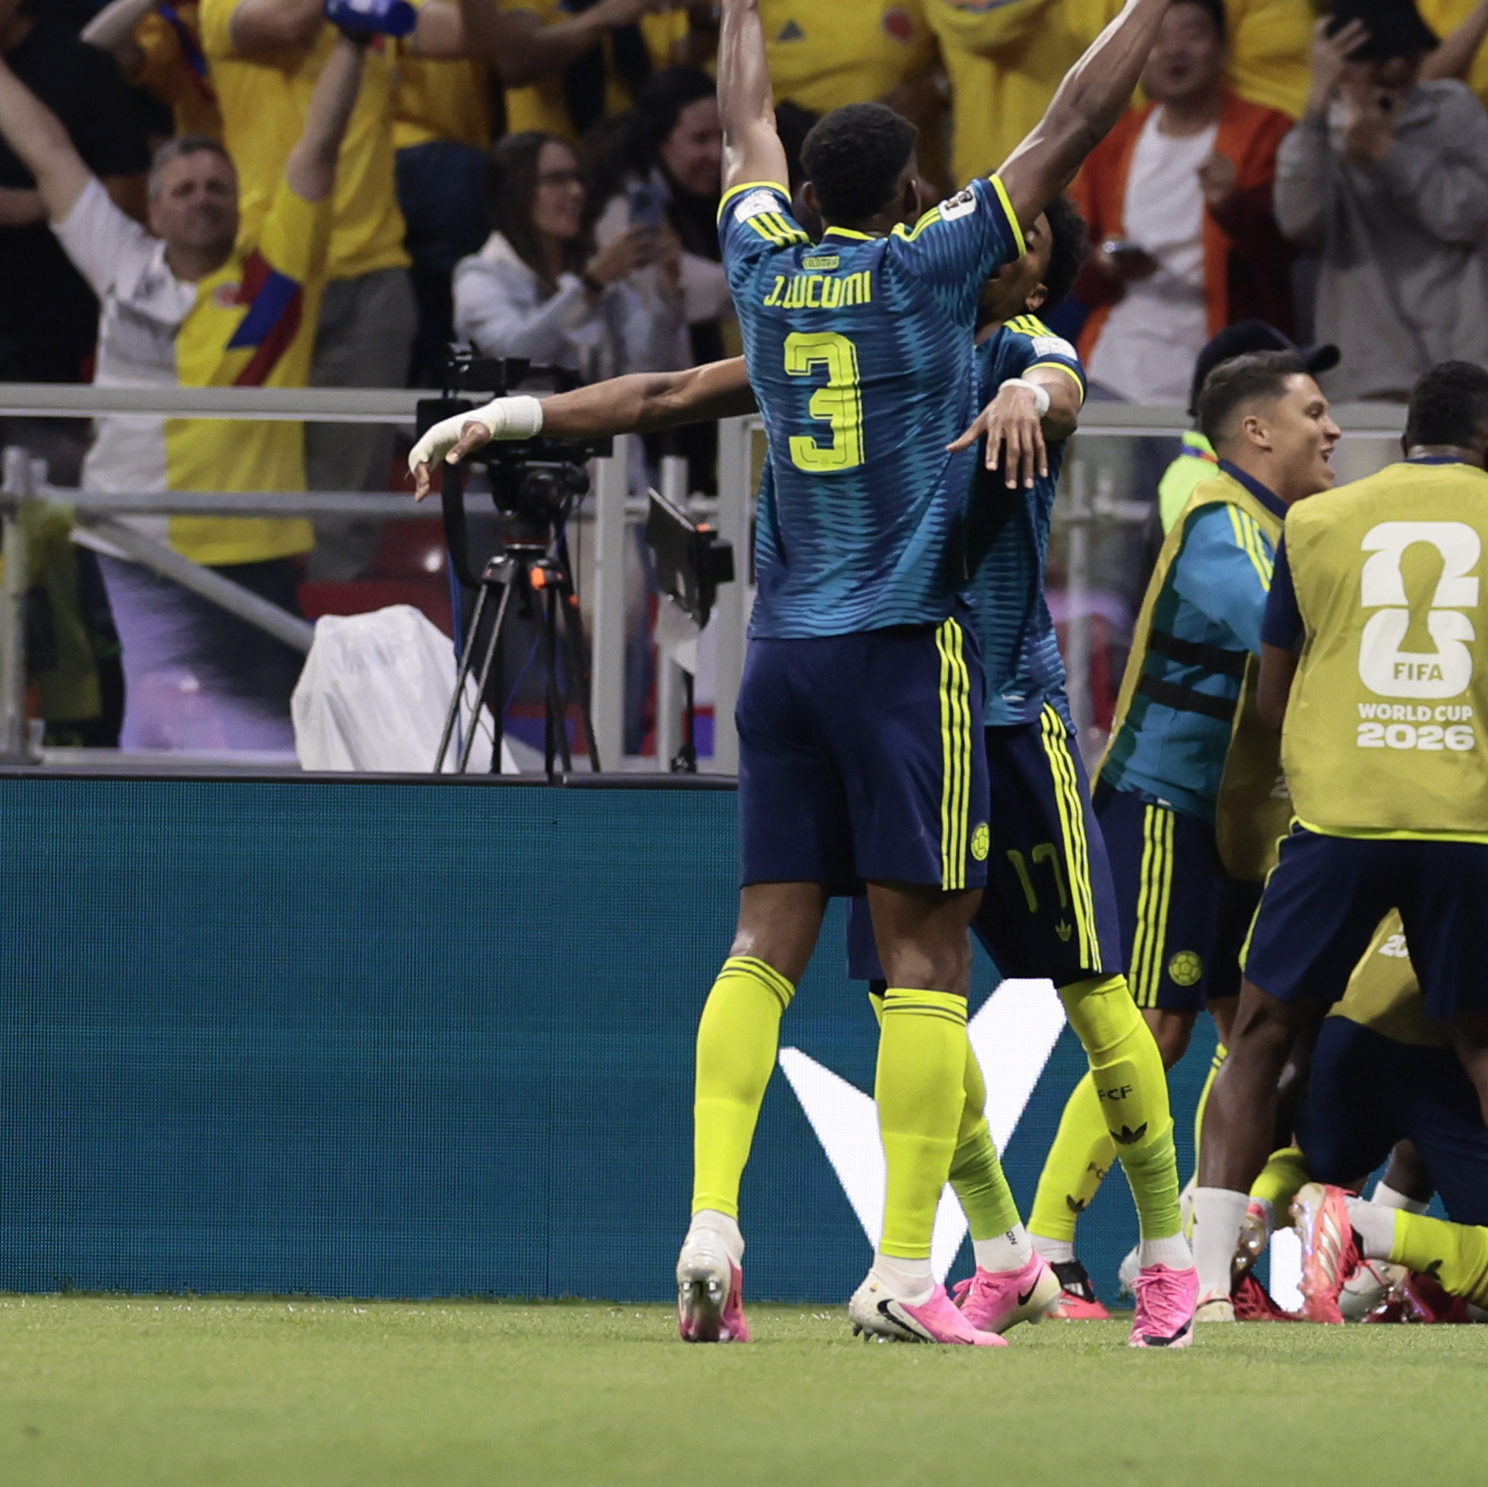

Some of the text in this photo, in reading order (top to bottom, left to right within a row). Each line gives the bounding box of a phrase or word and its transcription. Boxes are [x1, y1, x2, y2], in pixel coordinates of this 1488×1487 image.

[784, 331, 865, 472] 3
[1393, 662, 1443, 681] FIFA
[1357, 703, 1474, 722] WORLD CUP
[1357, 722, 1475, 751] 2026
[1006, 842, 1068, 913] 17
